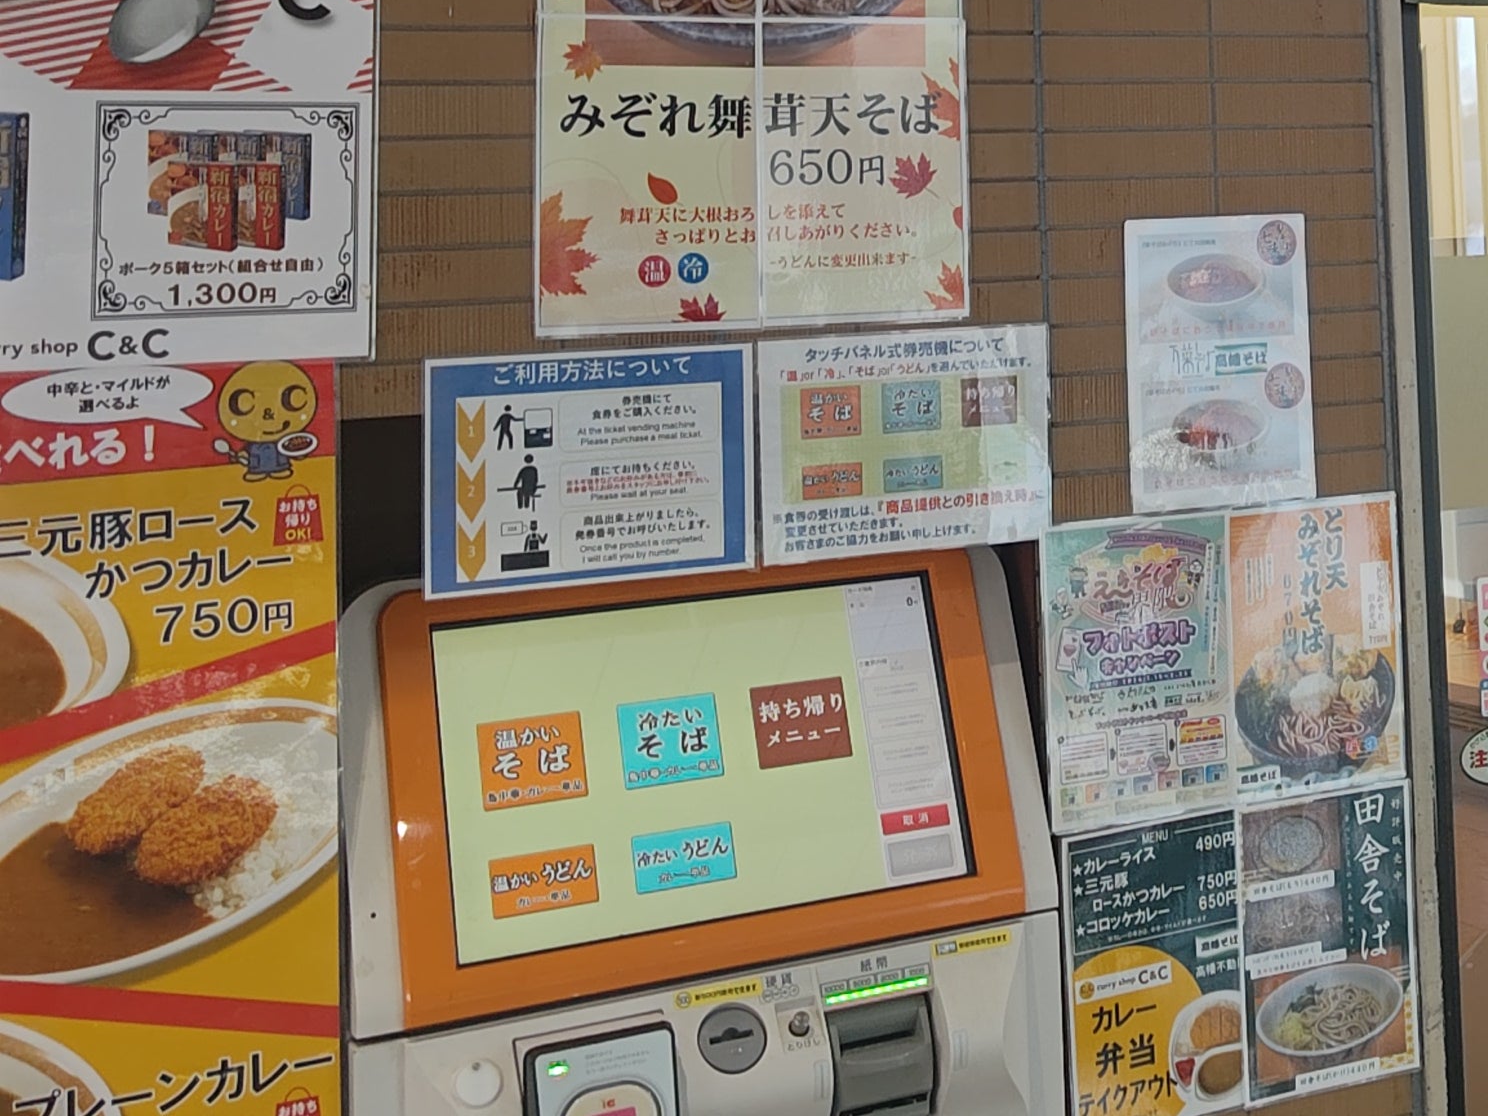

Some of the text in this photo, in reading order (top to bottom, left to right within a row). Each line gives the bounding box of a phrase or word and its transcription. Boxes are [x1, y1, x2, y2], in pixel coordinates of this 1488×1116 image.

[559, 92, 942, 140] みぞれ舞茸天そば
[770, 149, 885, 187] 650円
[683, 254, 703, 281] 冷
[168, 283, 277, 308] 1,300円
[30, 336, 78, 358] shop
[87, 328, 170, 361] C&C
[804, 337, 1004, 363] タッチパネル式券売機について
[493, 355, 692, 385] ご利用方法について
[79, 396, 139, 414] 選べるよ
[808, 405, 854, 422] そば
[892, 400, 935, 415] そば
[468, 426, 475, 437] 1
[0, 425, 155, 470] べれる！
[279, 498, 317, 513] お持ち
[468, 486, 475, 497] 2
[0, 497, 258, 558] 三元豚ロース
[468, 546, 475, 557] 3
[1324, 507, 1348, 590] とり天
[85, 548, 293, 600] かつカレー
[1298, 513, 1325, 655] みぞれそば
[155, 597, 294, 645] 750円
[638, 708, 703, 732] 冷たい
[759, 693, 844, 724] 持ち帰り
[495, 725, 560, 750] 温かい
[637, 726, 709, 758] そば
[766, 724, 842, 749] メニュー
[492, 744, 571, 779] そば
[1469, 750, 1488, 769] 注
[1141, 829, 1169, 844] MENU
[1196, 831, 1236, 852] 490円
[1084, 871, 1129, 896] 三元豚
[1197, 869, 1238, 891] 750円
[1353, 793, 1390, 961] 田舎そば
[1093, 884, 1185, 913] ロースかつカレー
[1087, 907, 1170, 934] コロッケカレー
[1092, 1002, 1157, 1034] カレー
[1095, 1034, 1156, 1078] 弁当
[14, 1052, 335, 1116] プレーンカレー
[1079, 1071, 1178, 1116] テイクアウト
